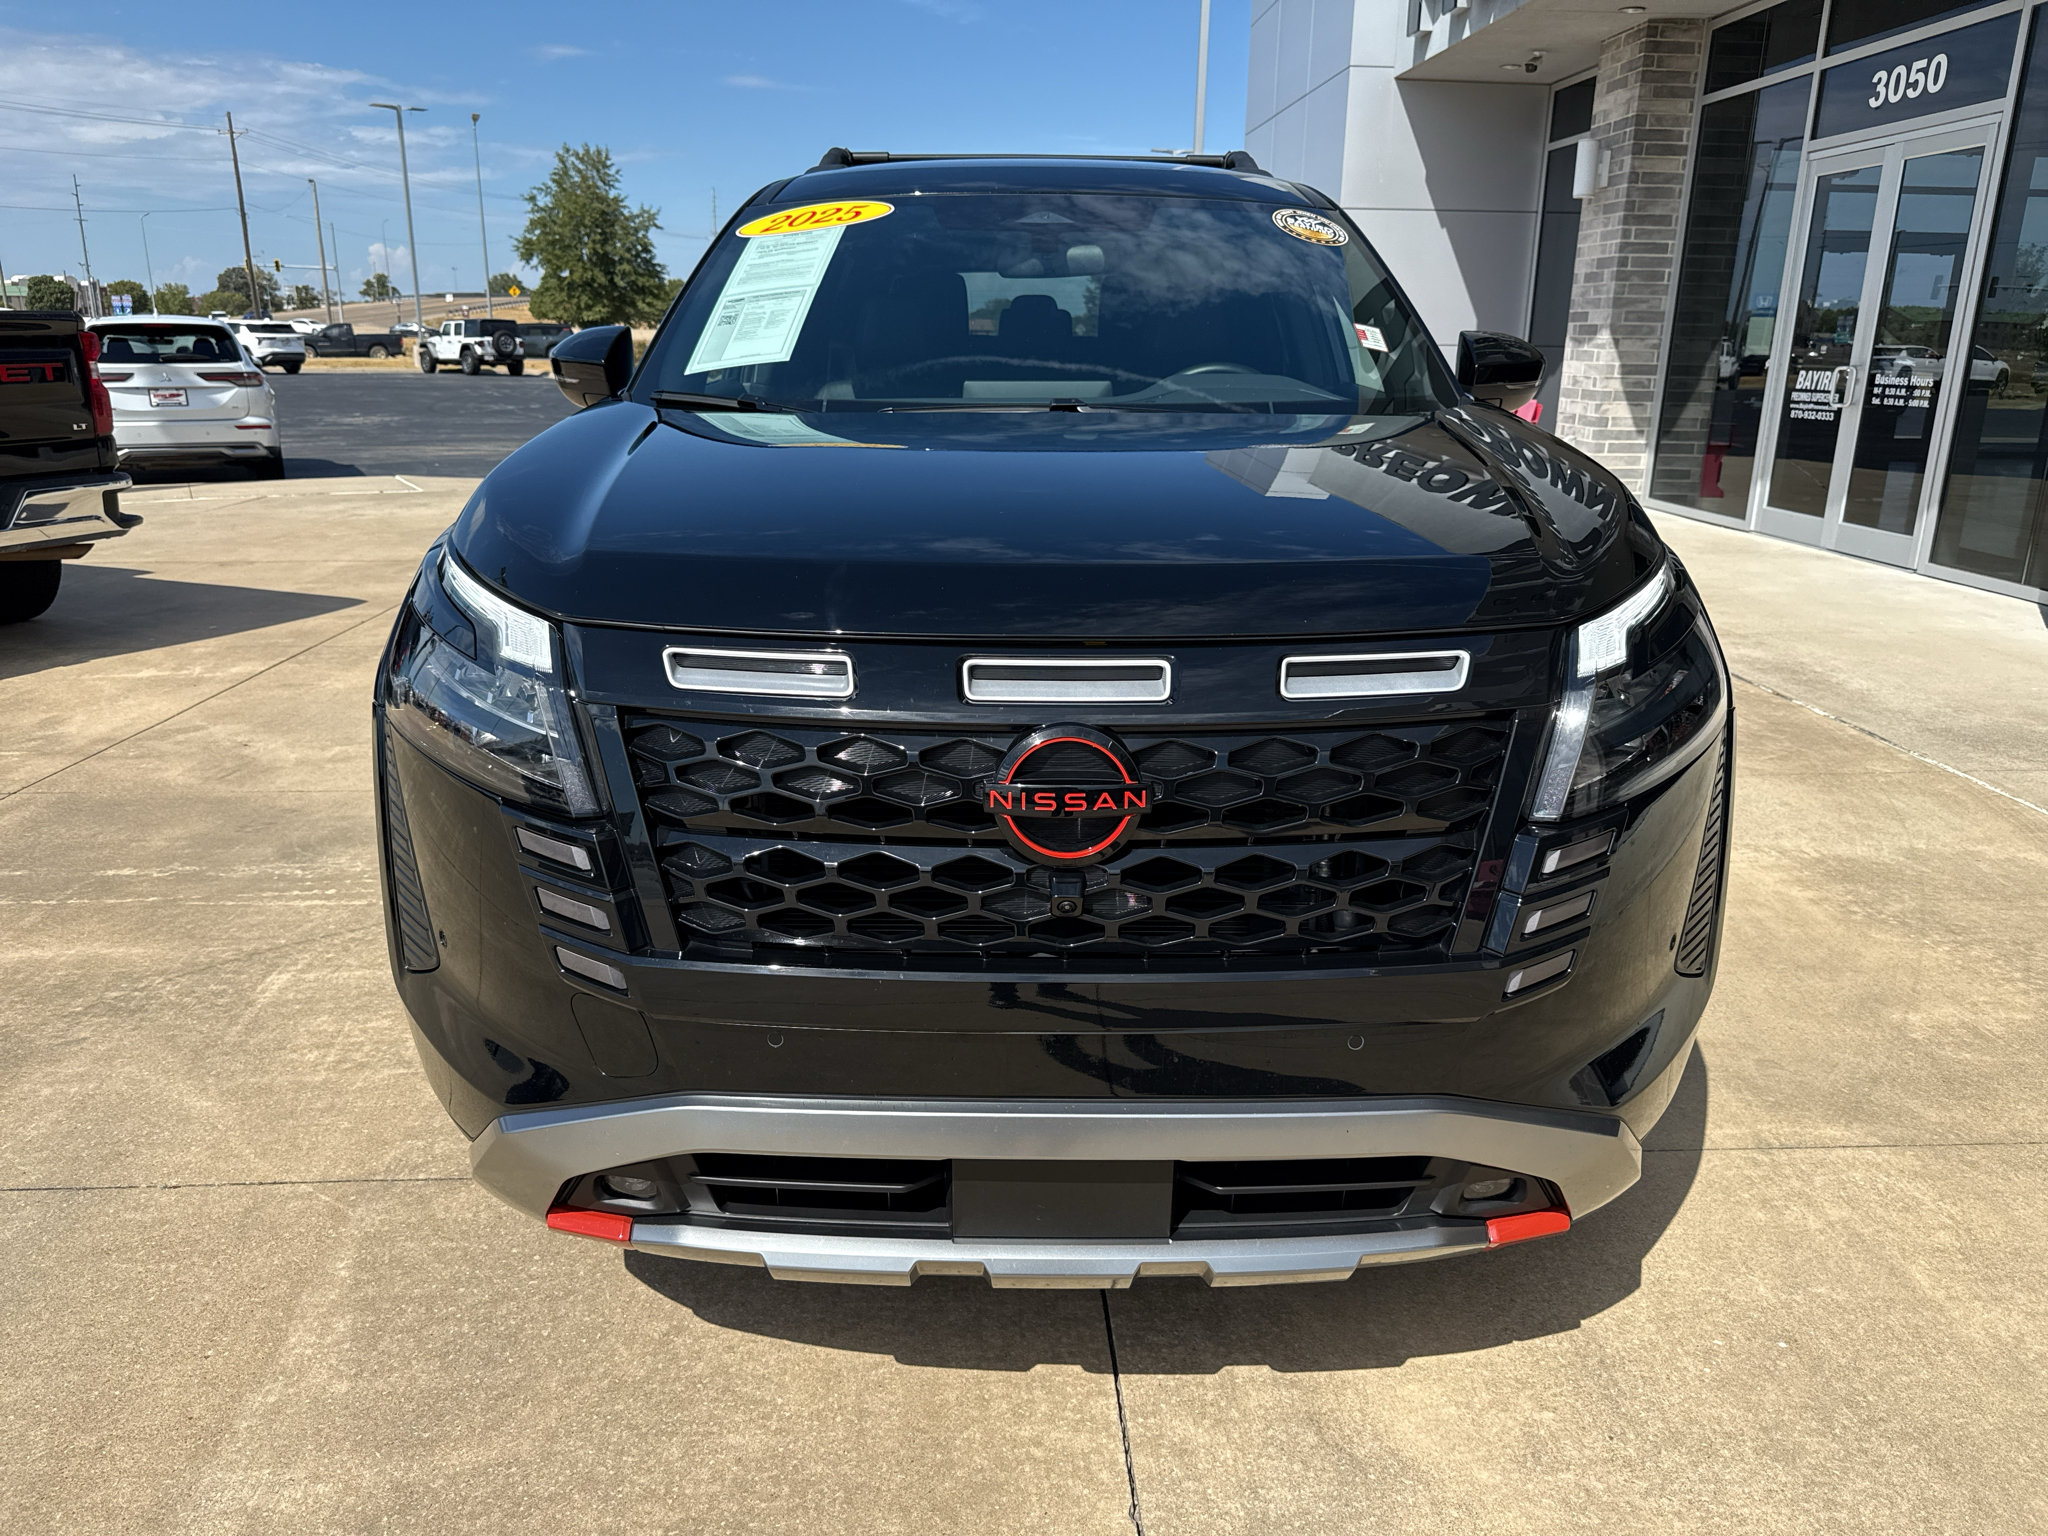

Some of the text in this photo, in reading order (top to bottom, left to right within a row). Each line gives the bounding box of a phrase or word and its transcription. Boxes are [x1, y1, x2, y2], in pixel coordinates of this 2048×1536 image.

[1868, 53, 1948, 109] 3050
[760, 205, 871, 234] 2025
[1874, 374, 1934, 387] Business Hours
[1790, 409, 1835, 421] 870-932-0333
[72, 423, 88, 431] LT
[989, 790, 1147, 812] NISSAN
